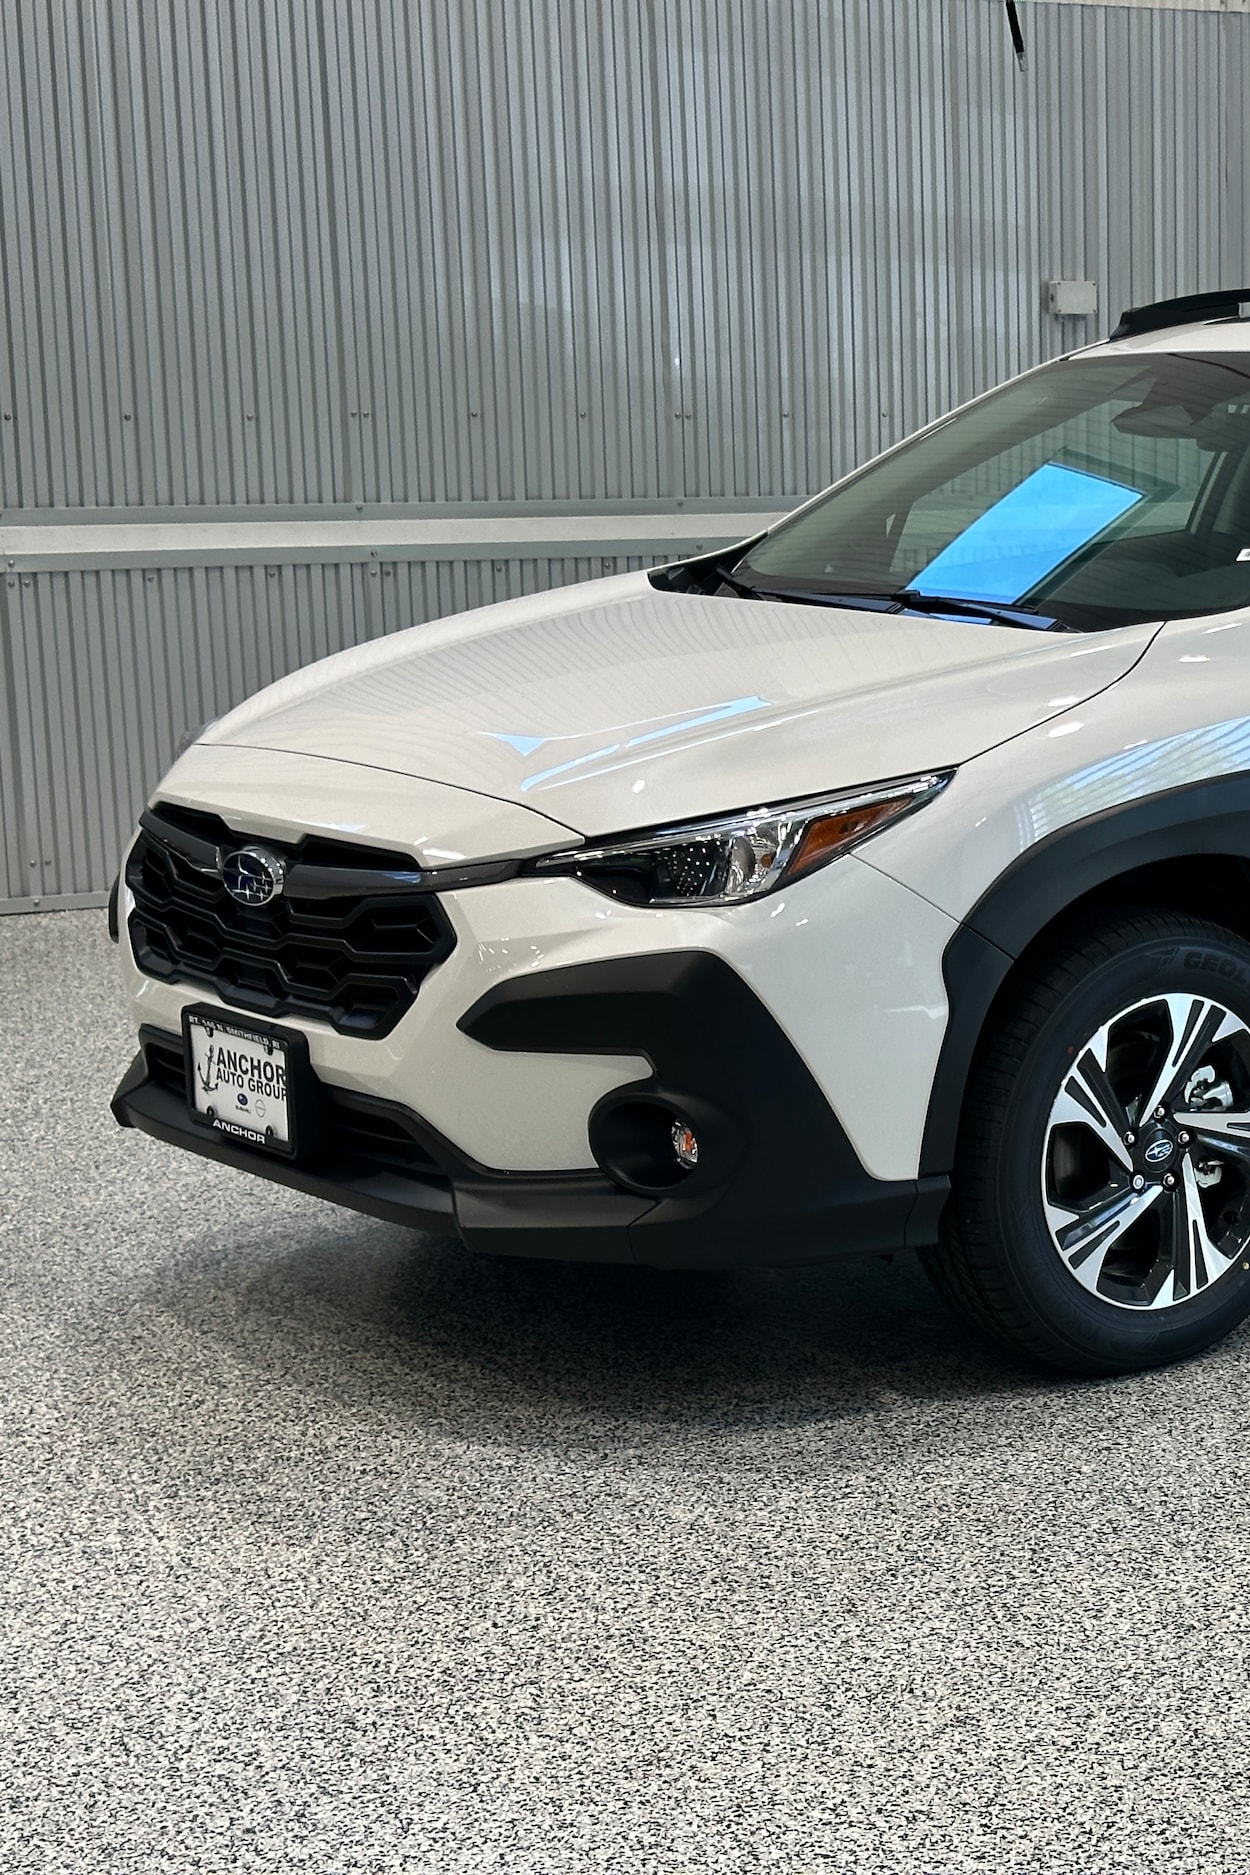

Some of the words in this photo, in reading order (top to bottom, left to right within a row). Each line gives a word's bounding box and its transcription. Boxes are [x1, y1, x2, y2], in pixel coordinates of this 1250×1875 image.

[216, 1047, 287, 1087] ANCHOR
[216, 1067, 244, 1089] AUTO
[248, 1078, 287, 1101] GROUP
[212, 1119, 266, 1145] ANCHOR
